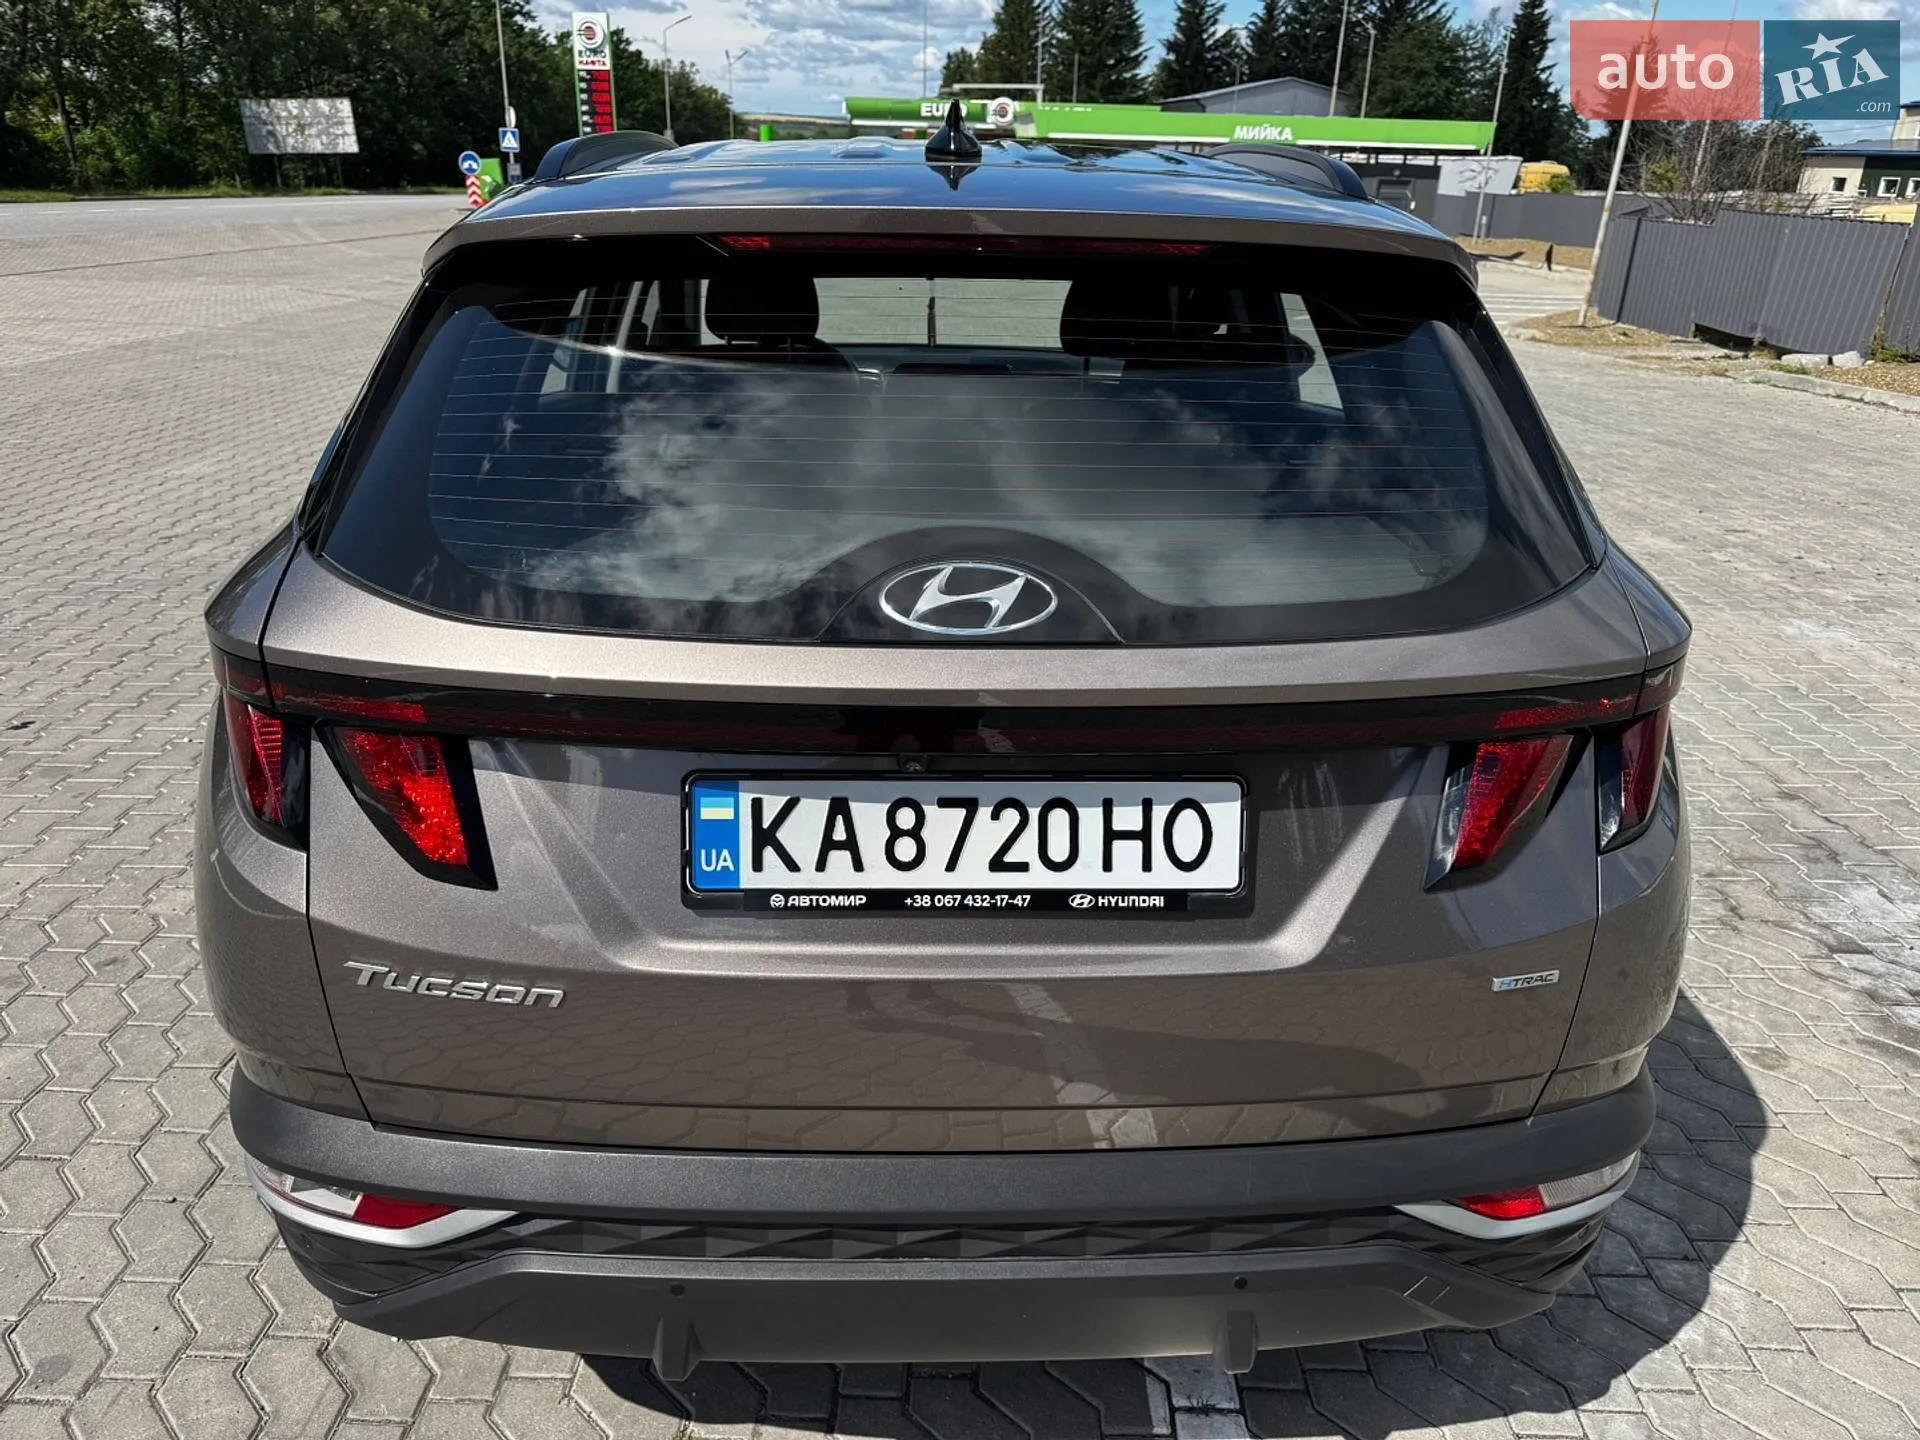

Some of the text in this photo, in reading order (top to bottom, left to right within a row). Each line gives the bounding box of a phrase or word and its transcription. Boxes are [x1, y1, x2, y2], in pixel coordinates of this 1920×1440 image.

[920, 102, 968, 117] EUO
[1233, 123, 1294, 141] МИЙКА
[700, 849, 735, 872] UA
[787, 894, 867, 907] АВТОМИР
[904, 894, 1031, 907] +38 067 432-17-47
[1098, 895, 1164, 908] HYUNDAI
